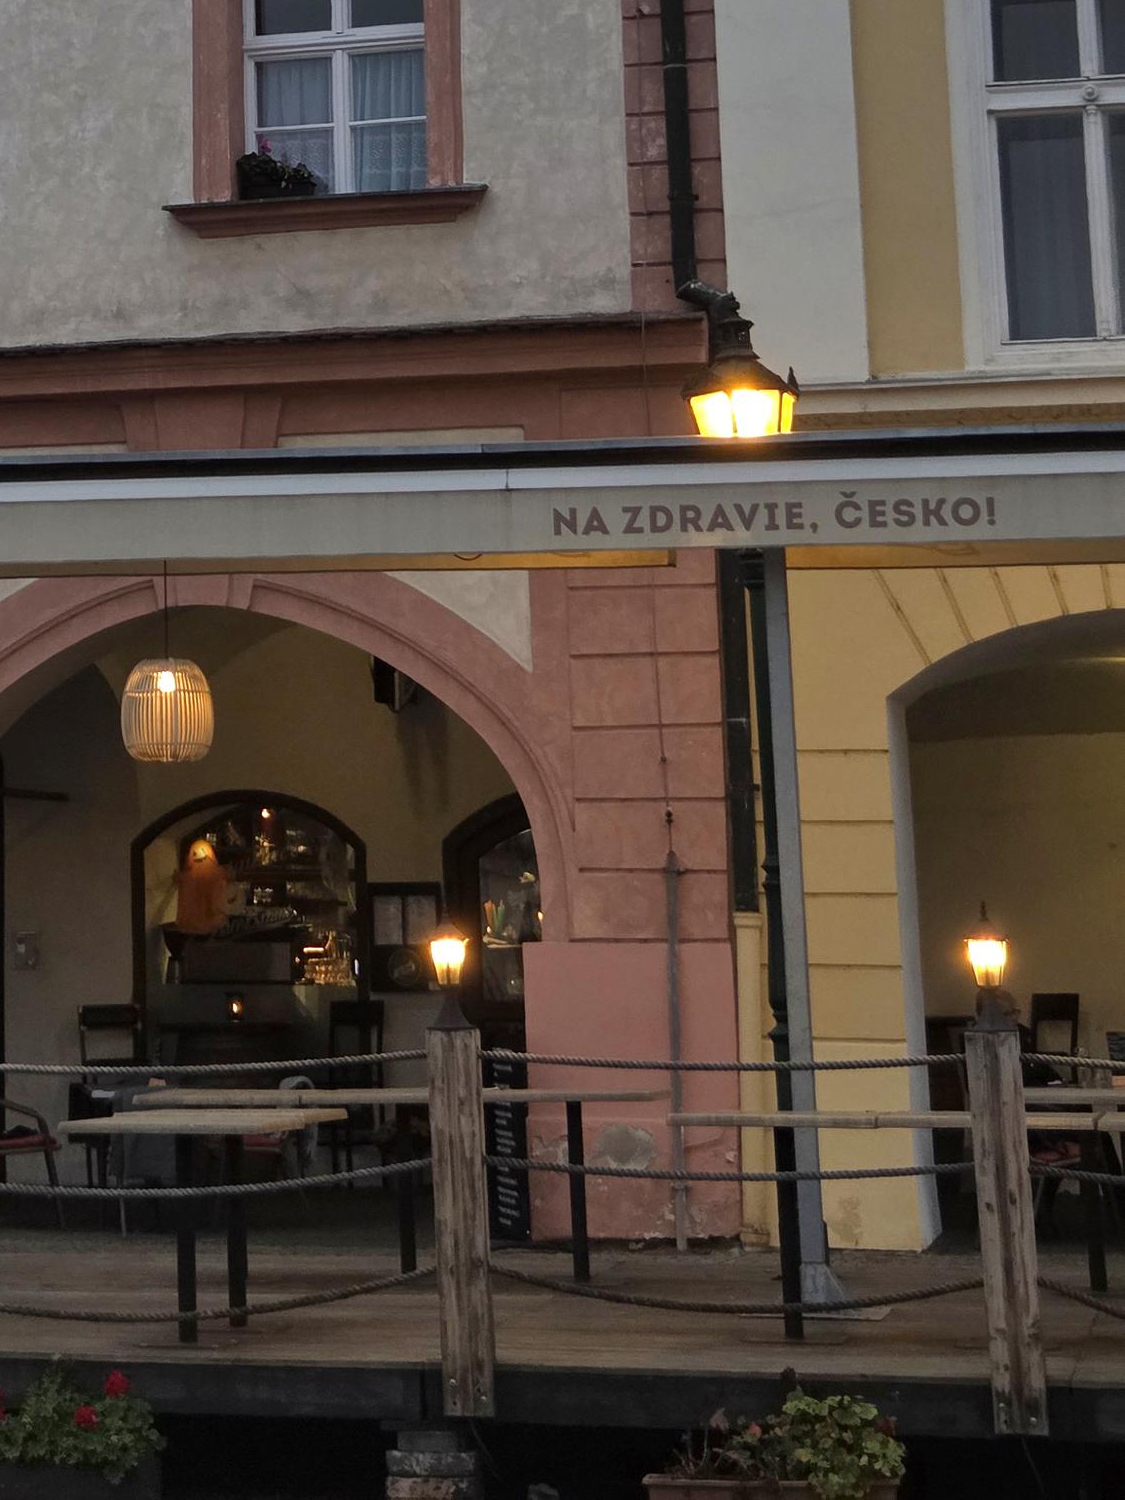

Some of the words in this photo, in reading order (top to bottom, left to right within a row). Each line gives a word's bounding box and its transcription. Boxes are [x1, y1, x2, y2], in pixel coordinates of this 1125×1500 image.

[552, 506, 610, 536] NA
[622, 501, 818, 534] ZDRAVIE,
[834, 491, 996, 530] ČESKO!
